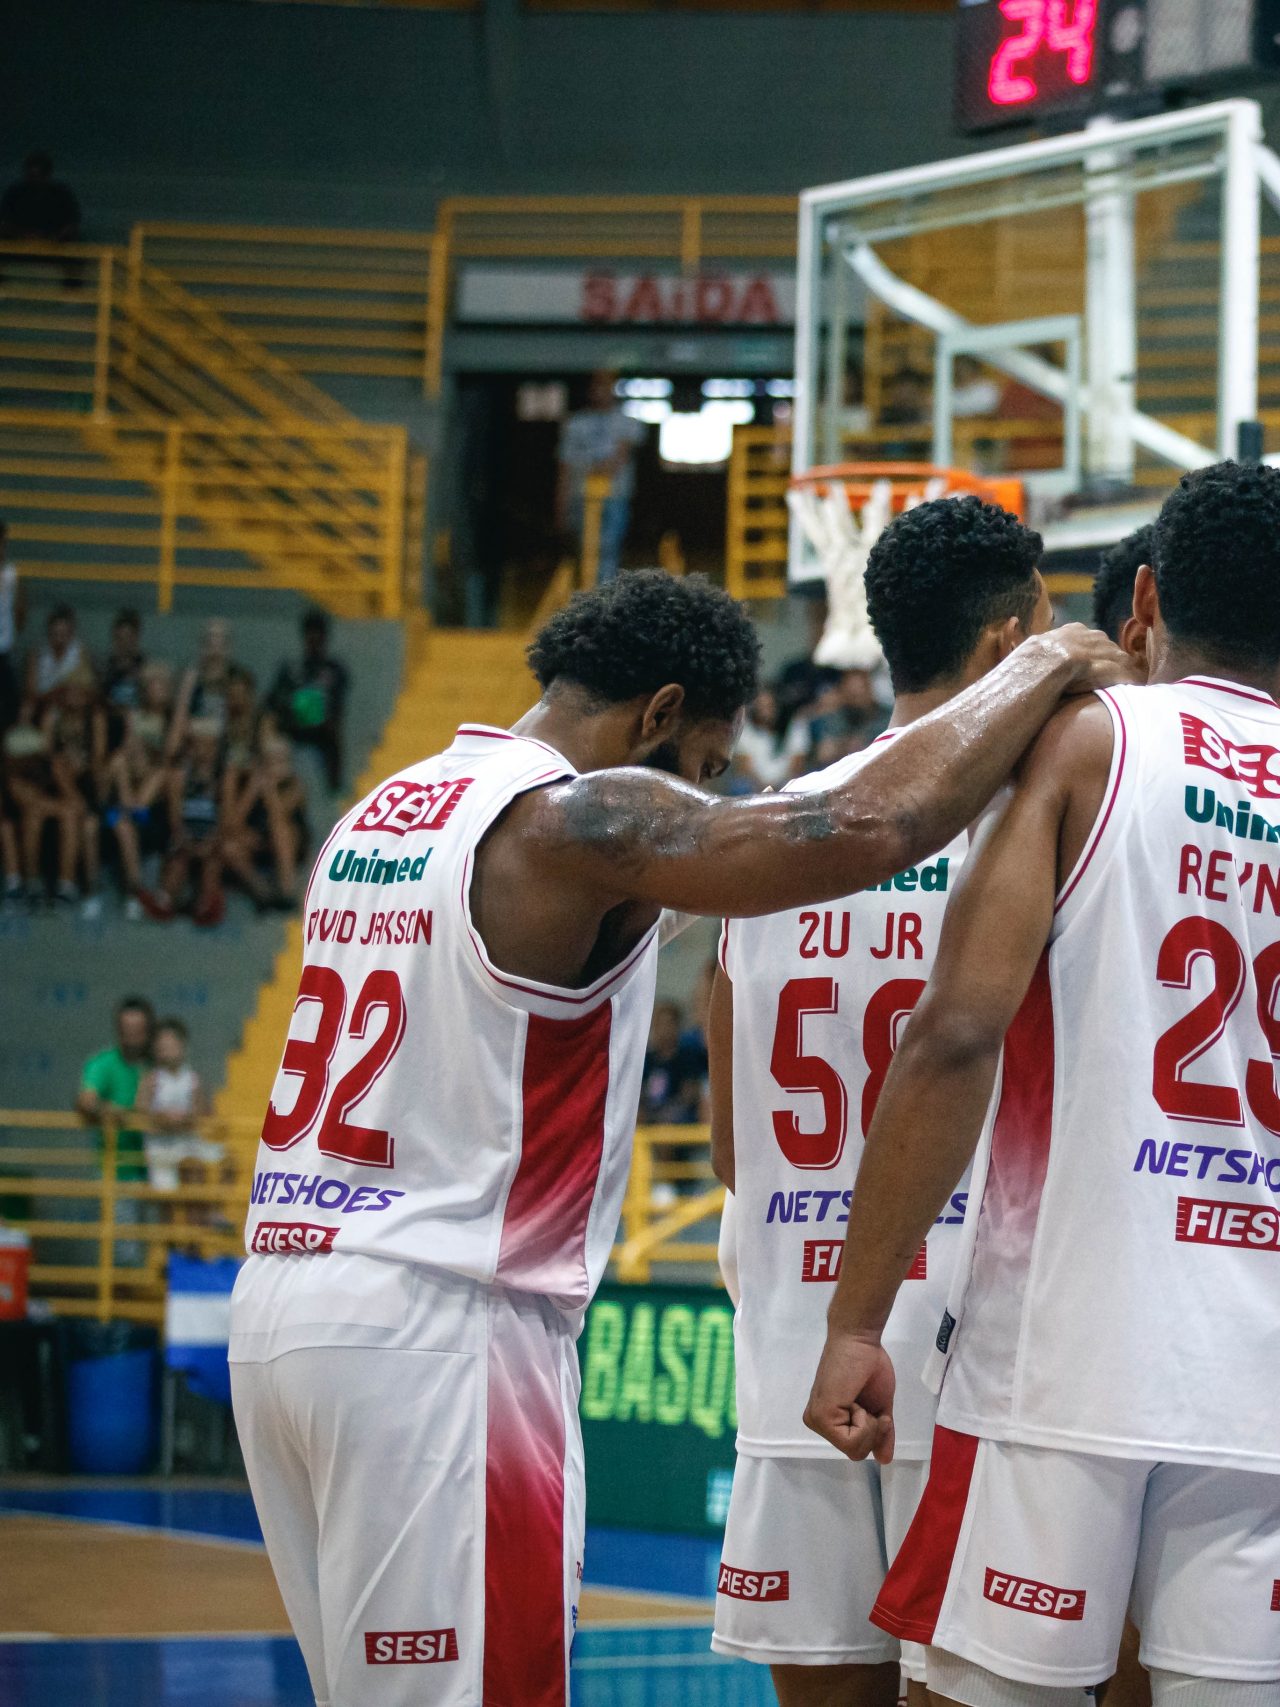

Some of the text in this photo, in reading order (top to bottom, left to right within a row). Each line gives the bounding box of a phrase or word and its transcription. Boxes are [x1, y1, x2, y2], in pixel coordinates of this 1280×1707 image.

[988, 0, 1098, 103] 24
[363, 783, 461, 831] SESI
[328, 846, 434, 886] Unimed
[869, 912, 924, 960] JR
[261, 965, 408, 1169] 32
[250, 1171, 406, 1214] NETSHOES
[255, 1227, 327, 1252] FIESP
[581, 1301, 738, 1439] BASQ
[718, 1568, 781, 1599] FIESP
[988, 1575, 1078, 1615] FIESP
[374, 1633, 448, 1662] SESI
